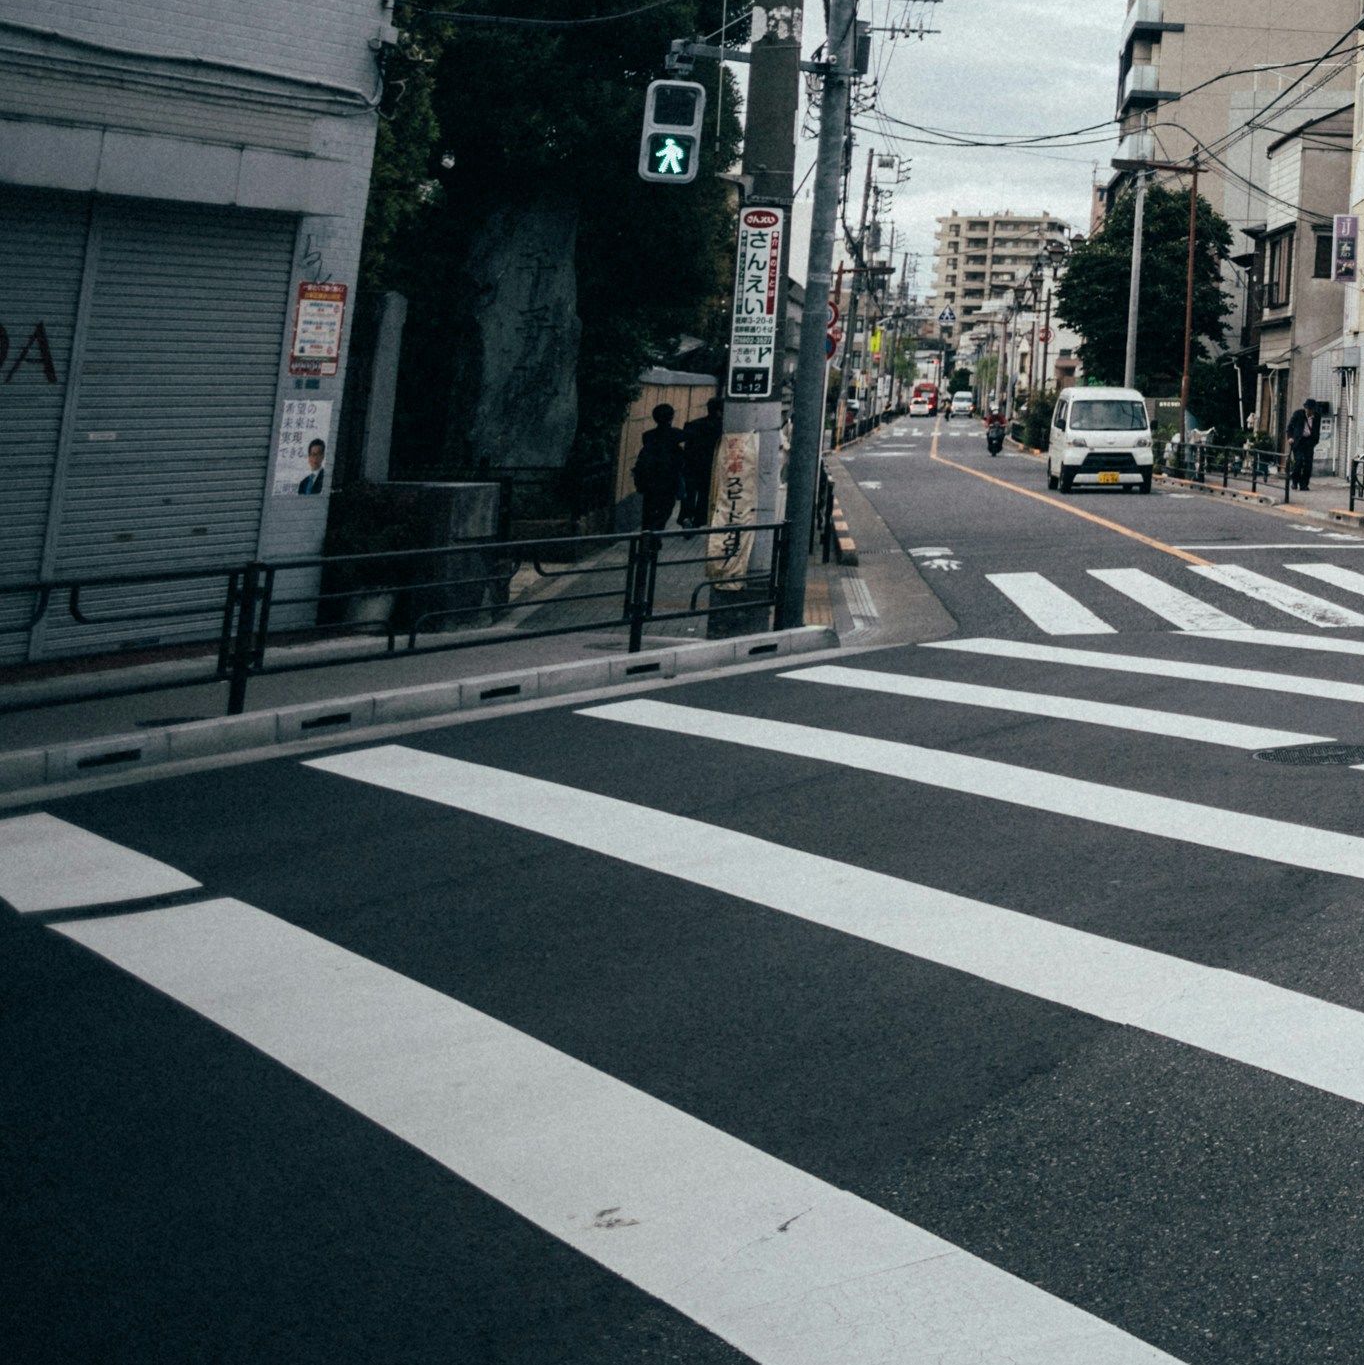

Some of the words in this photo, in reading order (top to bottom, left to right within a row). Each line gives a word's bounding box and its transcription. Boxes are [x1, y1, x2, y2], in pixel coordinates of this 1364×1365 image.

[745, 231, 769, 314] さんえい
[736, 384, 762, 392] 3-12
